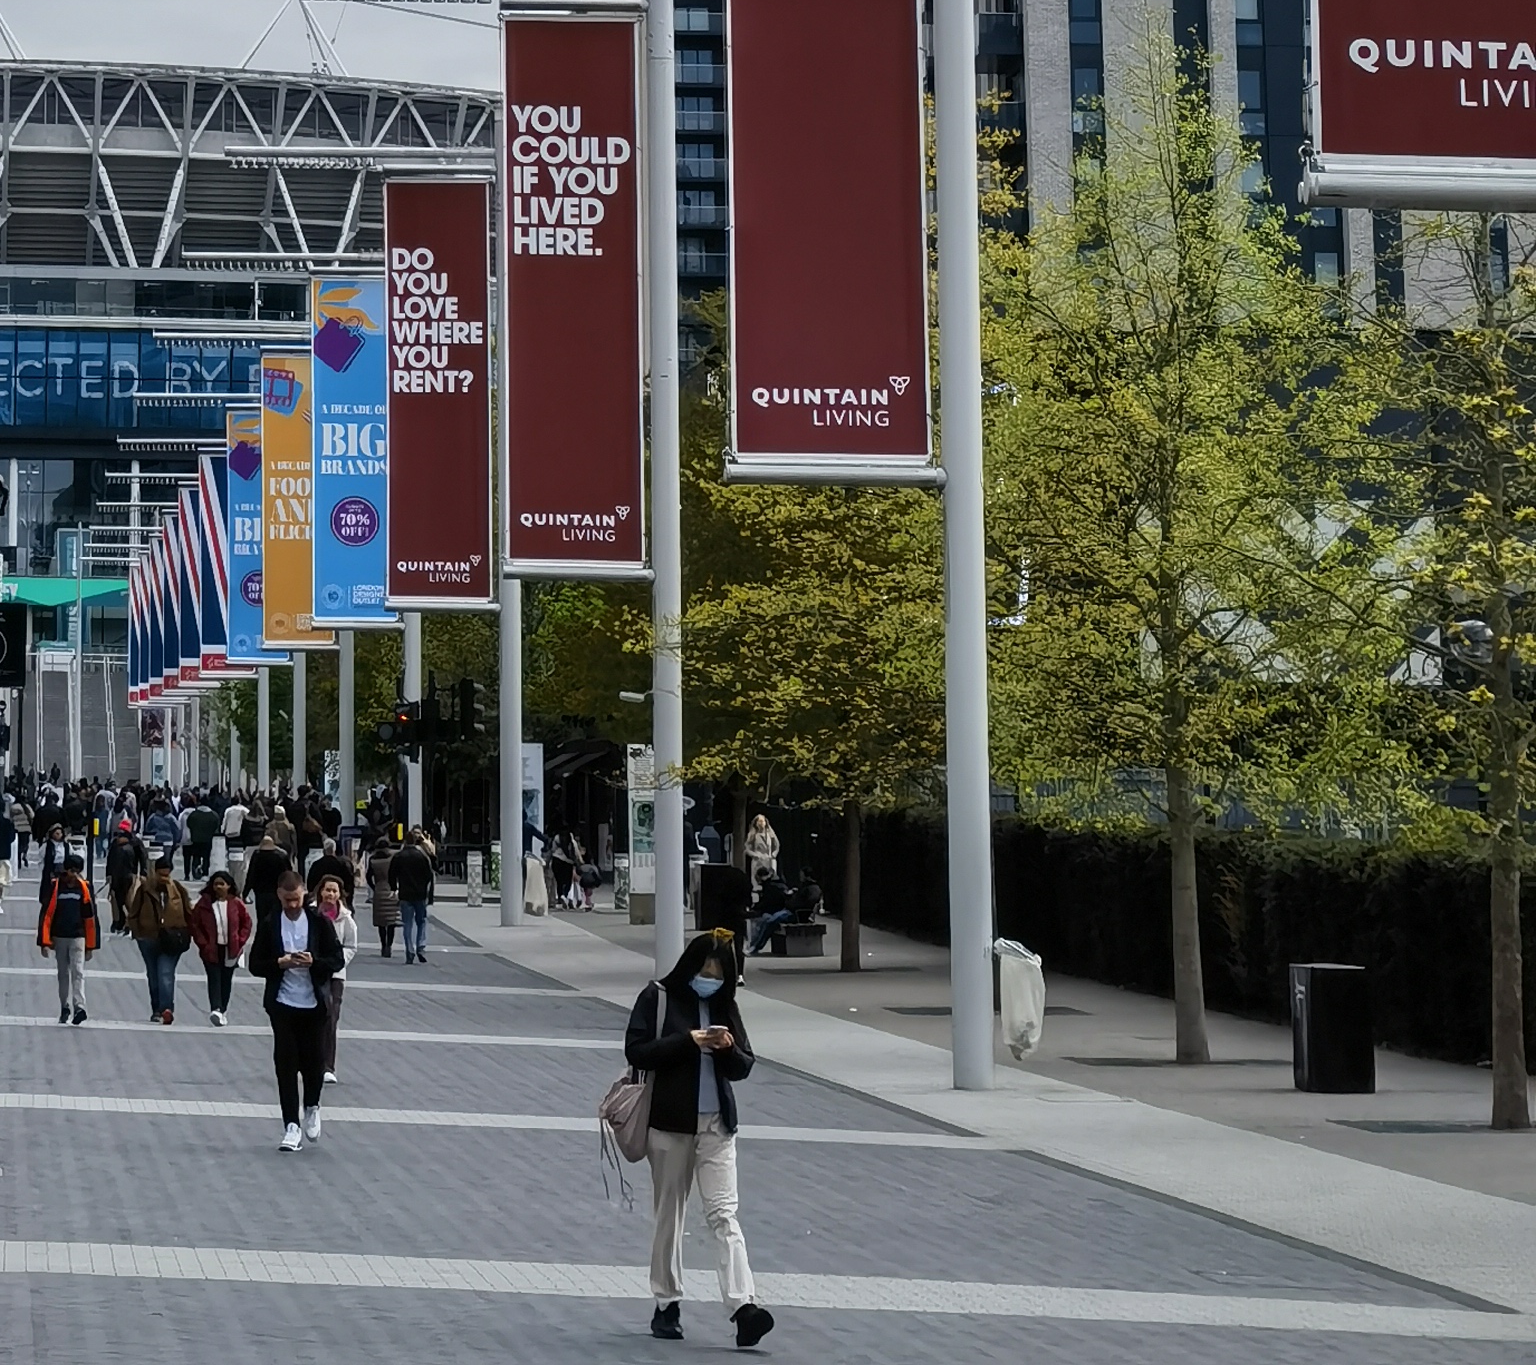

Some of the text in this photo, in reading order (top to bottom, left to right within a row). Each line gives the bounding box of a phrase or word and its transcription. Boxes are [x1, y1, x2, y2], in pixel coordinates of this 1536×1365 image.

[511, 105, 581, 134] YOU
[512, 135, 631, 164] COULD
[513, 166, 618, 195] IF YOU
[514, 196, 605, 225] LIVED
[514, 227, 603, 256] HERE.
[392, 248, 434, 270] DO
[392, 272, 448, 295] YOU
[392, 296, 458, 320] LOVE
[392, 321, 483, 344] WHERE
[392, 345, 449, 369] YOU
[165, 360, 227, 394] BY
[393, 369, 474, 393] RENT?
[752, 387, 888, 407] QUINTAIN
[813, 409, 890, 427] LIVING
[321, 422, 386, 457] BIG
[339, 513, 370, 525] 70%
[520, 513, 615, 527] QUINTAIN
[562, 529, 616, 542] LIVING
[397, 561, 470, 573] QUINTAIN
[429, 572, 470, 583] LIVING
[247, 582, 262, 592] 70
